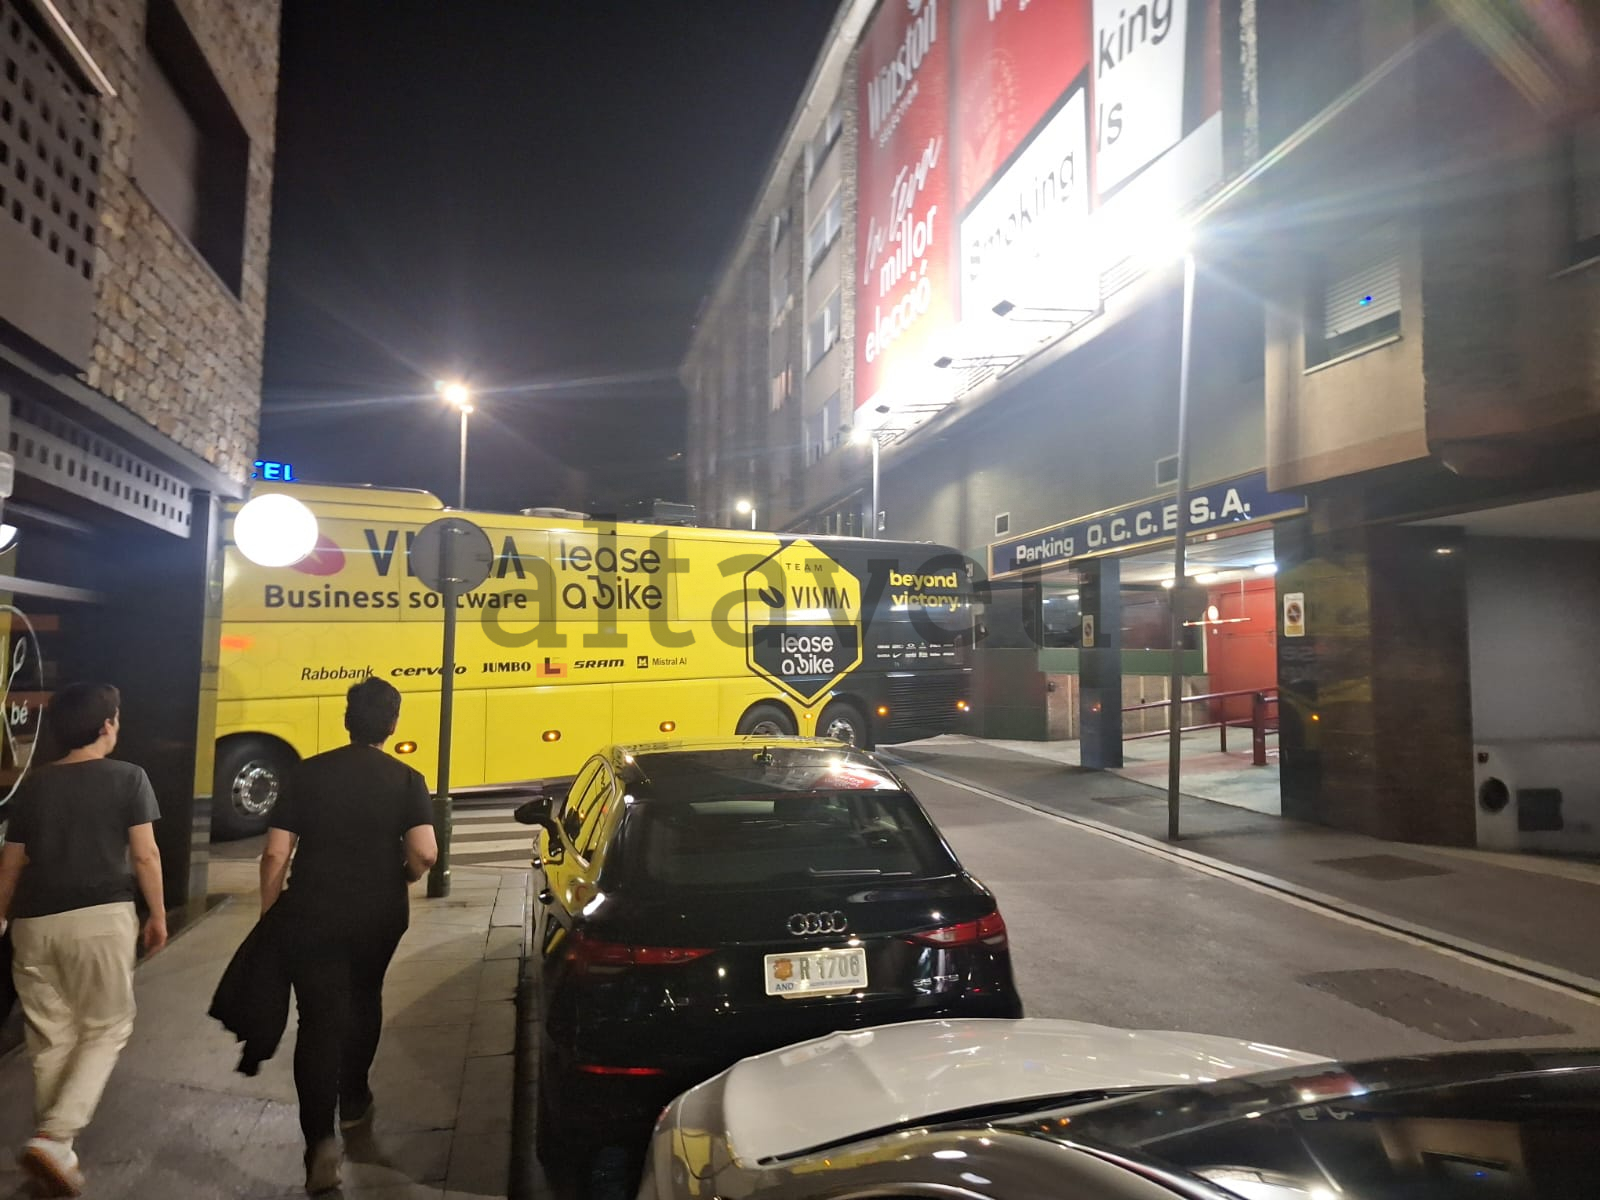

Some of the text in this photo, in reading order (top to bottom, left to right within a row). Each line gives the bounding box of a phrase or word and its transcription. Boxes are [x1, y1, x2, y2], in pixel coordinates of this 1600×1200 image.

[880, 204, 937, 298] millor
[1015, 488, 1251, 565] Parking O.C.C.ES.A.
[559, 539, 661, 574] lease
[785, 562, 823, 572] TEAM
[889, 569, 958, 590] beyond
[264, 583, 400, 609] Business
[791, 585, 851, 609] VISMA
[891, 593, 961, 613] victory.
[780, 632, 834, 653] lease
[301, 664, 375, 681] Rabobank
[390, 662, 468, 677] cervo
[481, 661, 532, 674] JUMBO
[573, 658, 625, 669] SRAM
[652, 657, 678, 666] Mistral
[799, 956, 811, 981] R
[775, 982, 795, 991] AND
